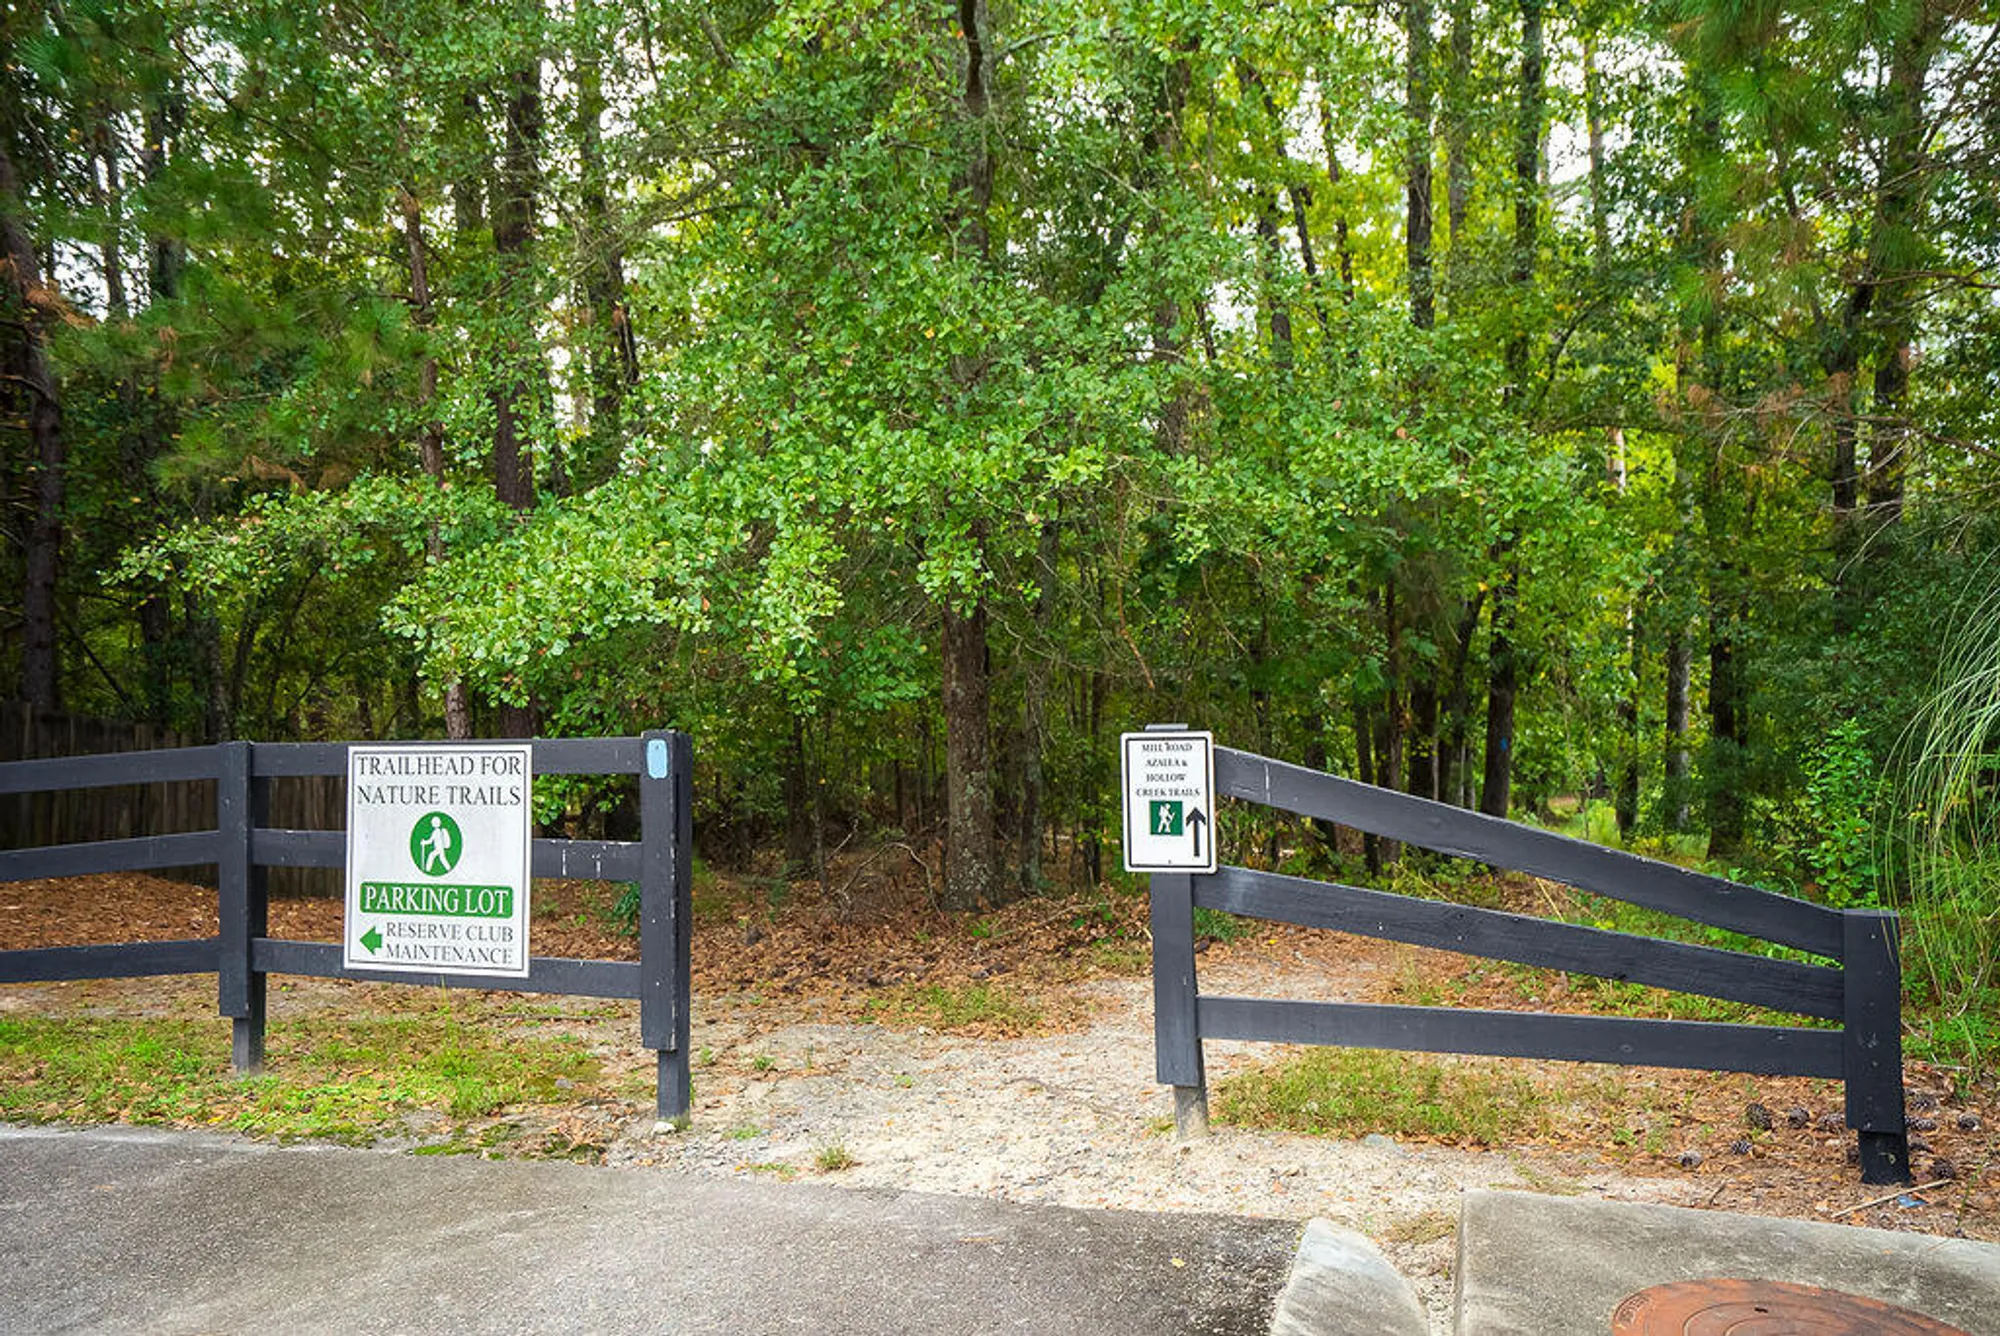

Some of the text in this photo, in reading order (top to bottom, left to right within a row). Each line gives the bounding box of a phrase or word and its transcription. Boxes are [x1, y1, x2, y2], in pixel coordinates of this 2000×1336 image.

[1142, 743, 1192, 752] MILL ROAD
[357, 756, 522, 776] TRAILHEAD FOR
[1146, 774, 1186, 782] HOLLOW
[357, 785, 521, 806] NATURE TRAILS
[1136, 788, 1200, 797] CREEK TRAILS
[365, 886, 508, 914] PARKING LOT
[386, 922, 513, 942] RESERVE CLUB
[385, 943, 513, 964] MAINTENANCE
